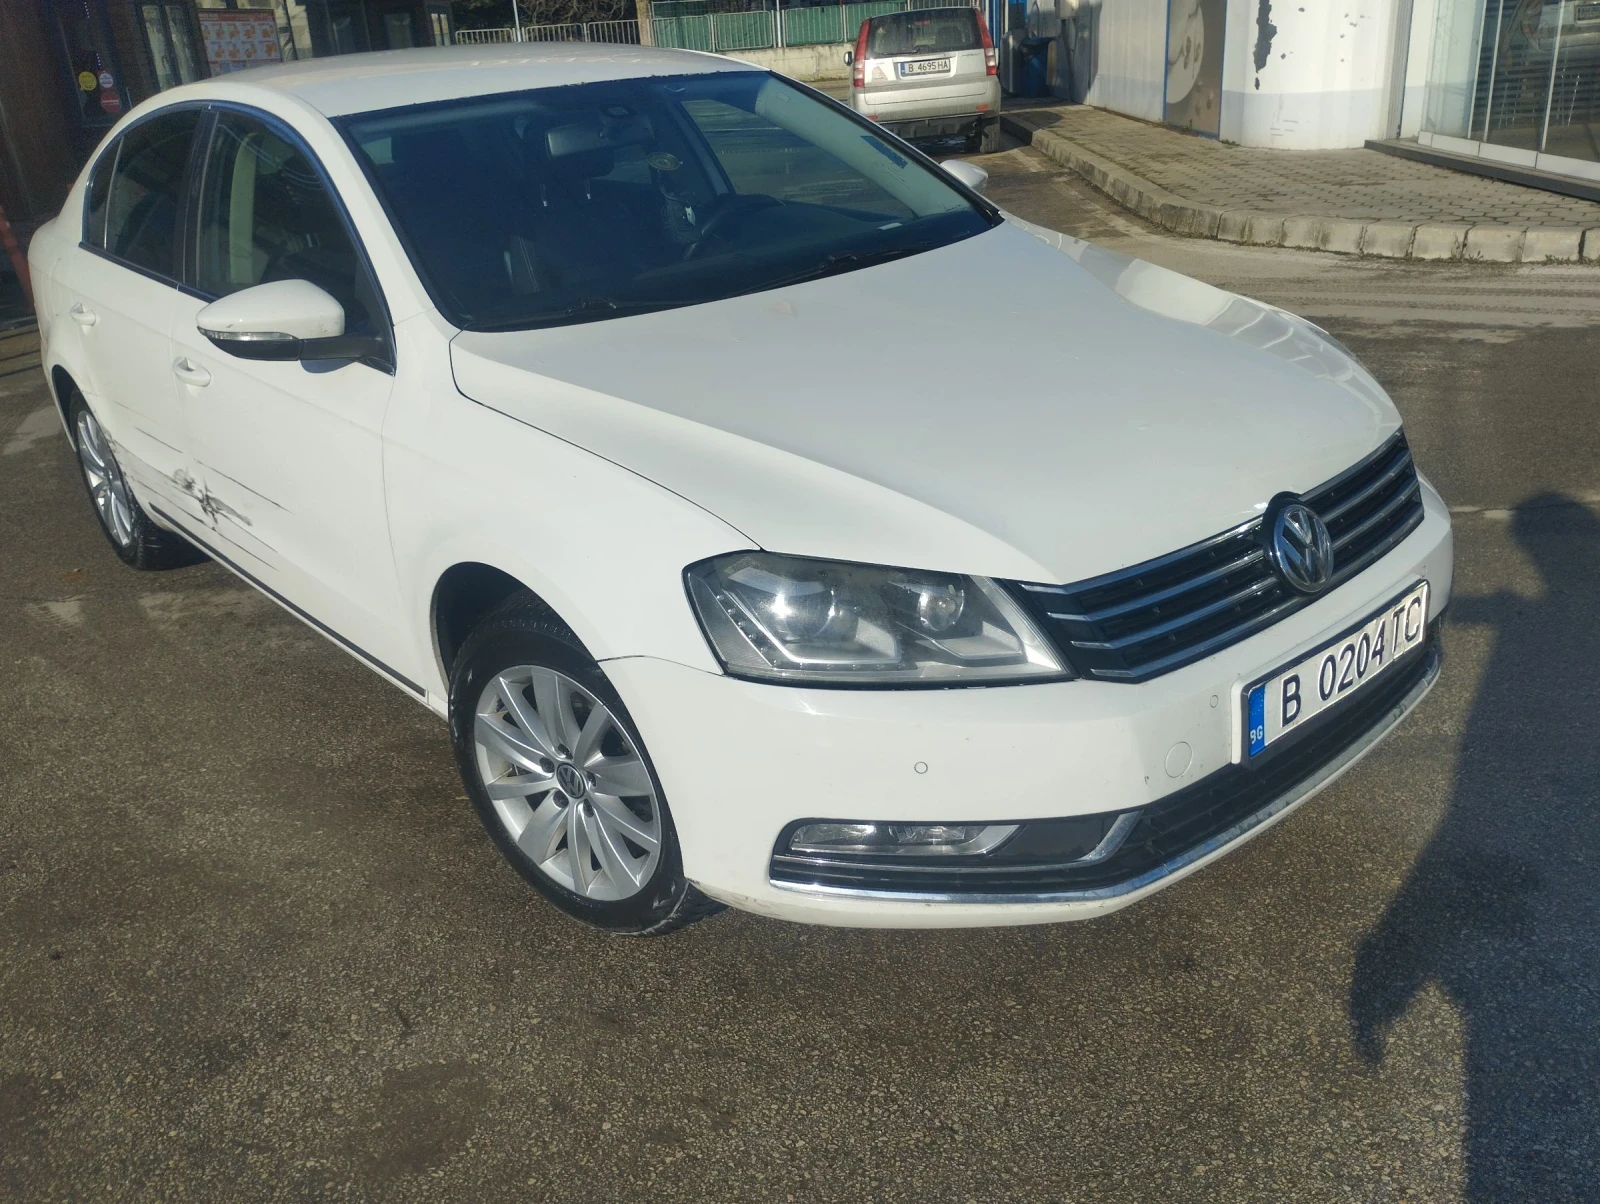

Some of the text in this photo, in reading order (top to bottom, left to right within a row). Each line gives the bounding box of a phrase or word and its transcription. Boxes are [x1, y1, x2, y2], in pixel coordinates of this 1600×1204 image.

[908, 60, 949, 73] B 4695 HA
[1281, 596, 1421, 728] B 0204 TC
[1250, 725, 1264, 745] BG
